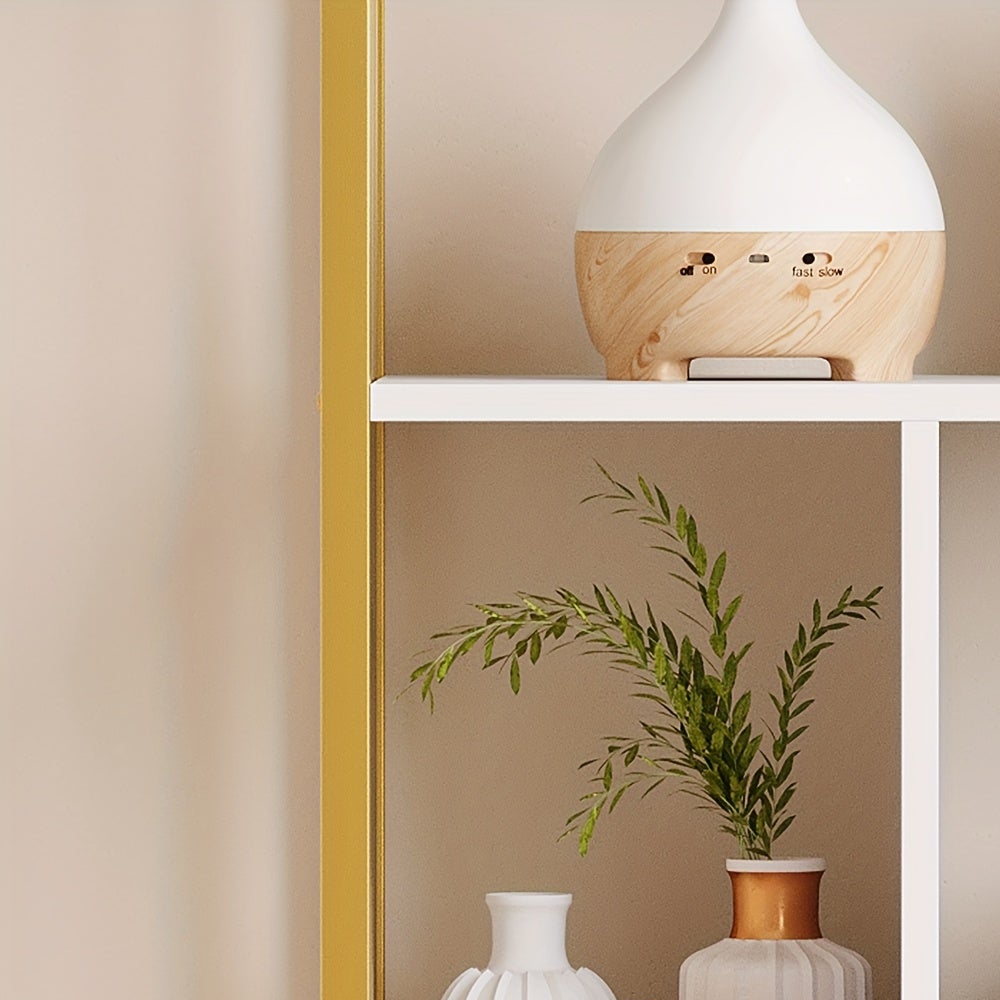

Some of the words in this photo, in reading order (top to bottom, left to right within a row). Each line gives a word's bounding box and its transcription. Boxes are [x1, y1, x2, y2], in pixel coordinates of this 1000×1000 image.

[702, 266, 717, 275] on
[792, 266, 814, 277] fast
[818, 267, 844, 277] slow
